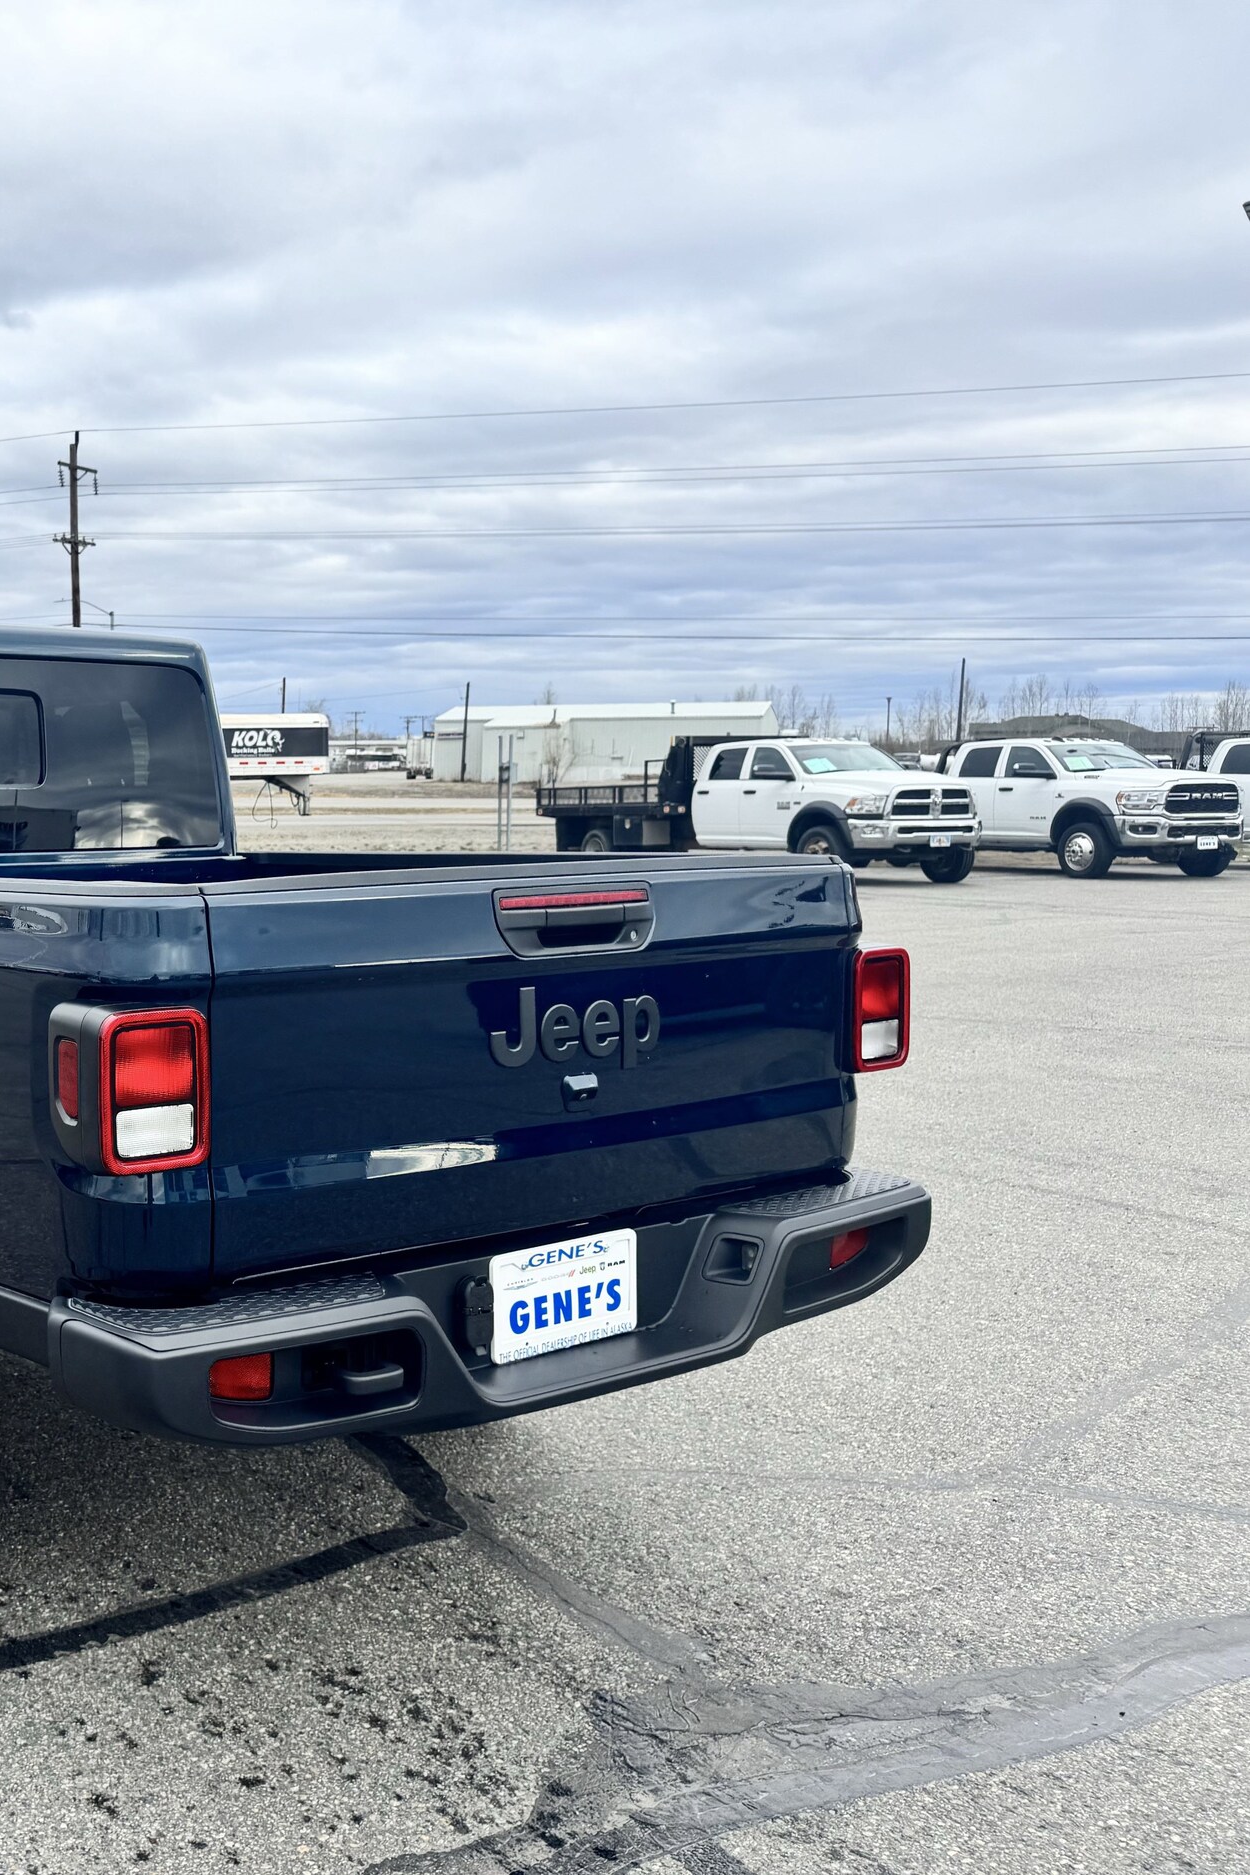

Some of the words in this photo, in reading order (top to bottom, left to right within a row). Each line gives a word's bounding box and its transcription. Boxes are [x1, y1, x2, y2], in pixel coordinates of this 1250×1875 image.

[490, 986, 661, 1070] Jeep
[528, 1240, 604, 1268] GENE'S
[579, 1264, 596, 1275] Jeep
[607, 1259, 626, 1268] RAM
[509, 1278, 621, 1335] GENE'S
[499, 1350, 511, 1364] THE
[513, 1344, 539, 1360] OFFICIAL
[541, 1335, 577, 1354] DEALERSHIP
[578, 1332, 587, 1344] OF
[589, 1329, 600, 1341] LIFE
[601, 1328, 609, 1338] IN
[610, 1322, 632, 1335] ALASKA
